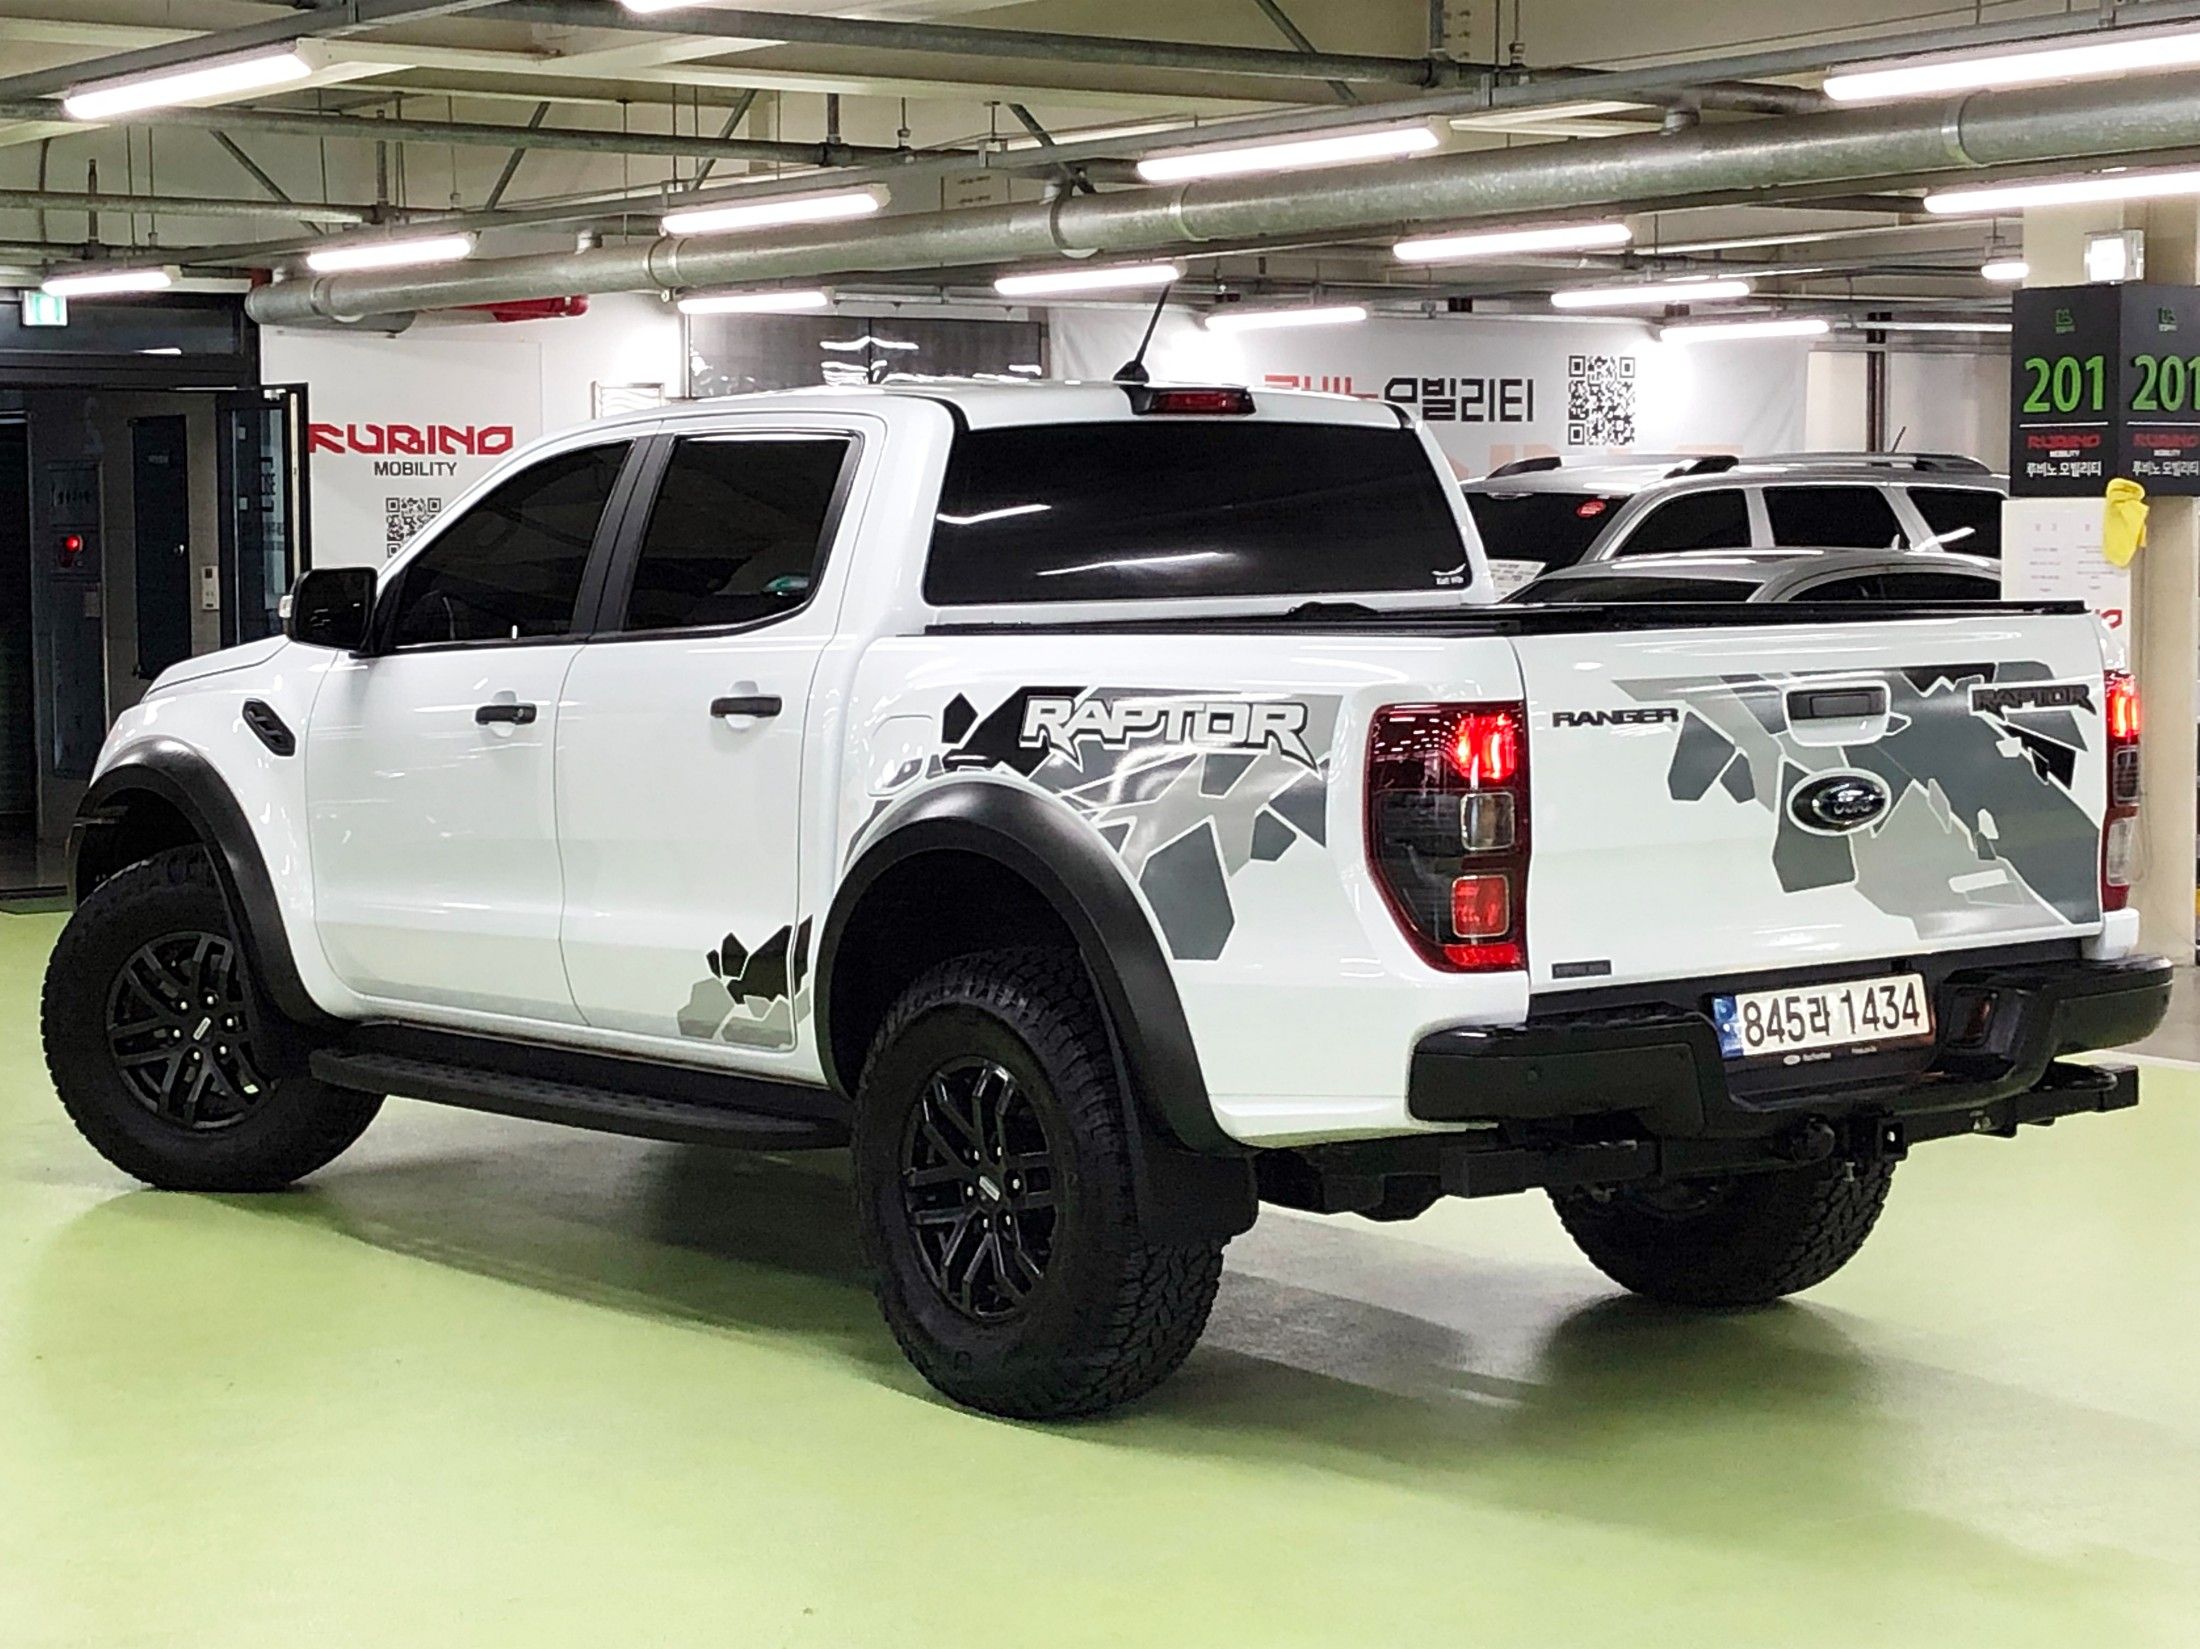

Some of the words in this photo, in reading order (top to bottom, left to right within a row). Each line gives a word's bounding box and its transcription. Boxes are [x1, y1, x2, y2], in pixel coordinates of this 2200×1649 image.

[2023, 355, 2105, 412] 201
[2132, 354, 2200, 411] 201
[374, 461, 458, 476] MOBILITY
[1552, 708, 1679, 727] RANGER
[1971, 684, 2097, 721] RAPTOR
[1019, 696, 1321, 778] RAPTOR
[1743, 995, 1831, 1047] 845라
[1840, 981, 1921, 1035] 1434
